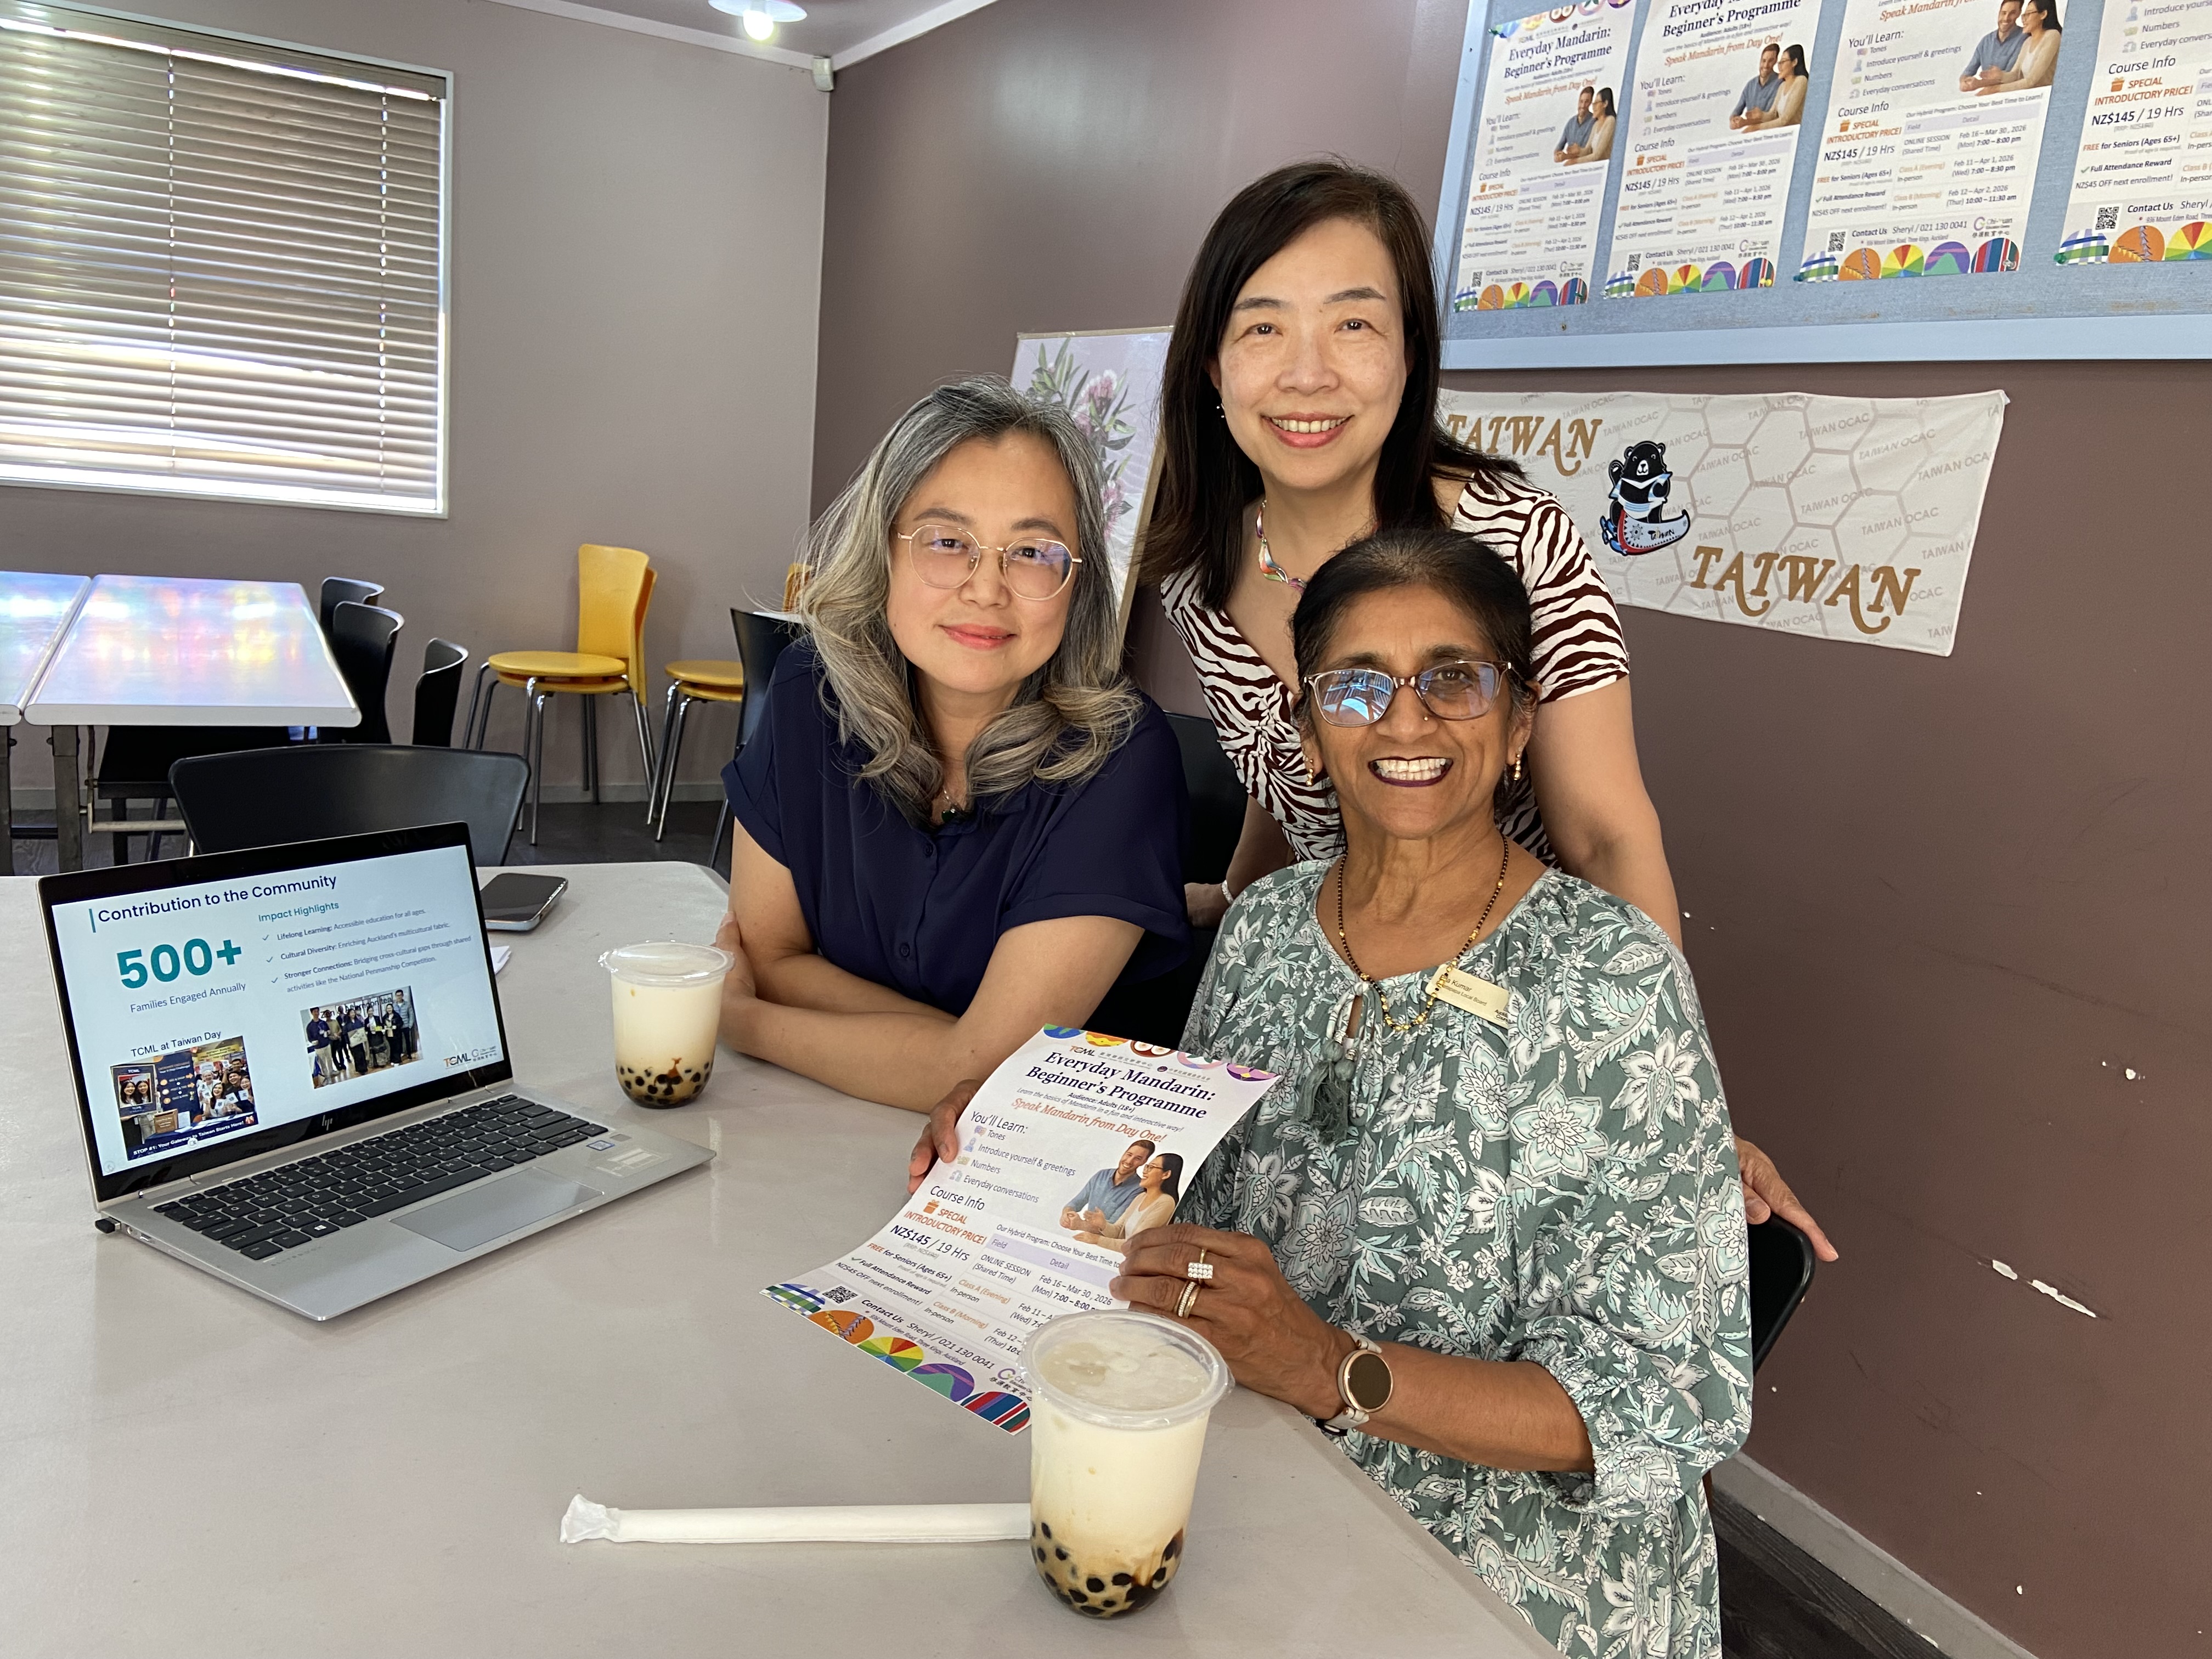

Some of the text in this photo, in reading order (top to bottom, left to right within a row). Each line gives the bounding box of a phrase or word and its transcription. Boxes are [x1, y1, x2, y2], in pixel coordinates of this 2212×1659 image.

[2142, 21, 2180, 32] Numbers
[2109, 55, 2176, 74] Course Info
[2095, 85, 2193, 106] INTRODUCTORY PRICE!
[2128, 77, 2163, 89] SPECIAL
[2092, 111, 2135, 126] NZ$145
[2147, 108, 2161, 119] 19
[2164, 106, 2184, 117] Hrs
[2113, 140, 2139, 148] Seniors
[2141, 138, 2161, 146] (Ages
[2163, 134, 2180, 143] 65+)
[1824, 149, 1858, 161] NZ$145
[1447, 414, 1603, 476] TAIWAN
[1690, 545, 1921, 634] TAIWAN
[98, 876, 336, 922] Contribution to the Community
[258, 902, 339, 922] Impact Highlights
[277, 932, 303, 940] Lifelong
[304, 926, 332, 935] Learning:
[334, 920, 364, 930] Accessible
[365, 915, 394, 924] education
[280, 950, 306, 960] Cultural
[307, 945, 337, 955] Diversity:
[338, 939, 366, 949] Enriching
[284, 969, 312, 979] Stronger
[313, 961, 353, 973] Connections:
[353, 956, 379, 965] Bridging
[431, 940, 453, 949] through
[453, 935, 471, 944] shared
[116, 938, 242, 989] 500+
[287, 983, 314, 992] activities
[339, 970, 364, 981] National
[365, 964, 400, 975] Penmanship
[130, 982, 246, 1013] Families Engaged Annually
[131, 1031, 221, 1057] TCML at Taiwan Day
[1043, 1052, 1121, 1079] Everyday
[1120, 1069, 1215, 1101] Mandarin:
[1025, 1066, 1207, 1118] Beginner's Programme
[1067, 1092, 1136, 1113] Audience: Adults (18+)
[970, 1111, 1028, 1134] You'll Learn:
[1011, 1098, 1167, 1142] Speak Mandarin from Day One!
[988, 1130, 1006, 1141] Tones
[970, 1159, 1001, 1174] Numbers
[978, 1144, 1009, 1159] Introduce
[1009, 1154, 1035, 1164] yourself
[1042, 1163, 1076, 1177] greetings
[930, 1186, 985, 1210] Course Info
[963, 1175, 1039, 1203] Everyday conversations
[904, 1211, 987, 1245] INTRODUCTORY PRICE!
[938, 1209, 967, 1224] SPECIAL
[890, 1225, 930, 1245] NZ$145
[936, 1243, 952, 1253] 19
[951, 1247, 970, 1261] Hrs
[991, 1239, 1008, 1249] Field
[1007, 1227, 1026, 1238] Hybrid
[1025, 1233, 1051, 1246] Program:
[1051, 1242, 1071, 1253] Choose
[1073, 1248, 1085, 1256] Your
[1085, 1252, 1098, 1261] Best
[1099, 1256, 1113, 1266] Time
[867, 1243, 884, 1252] FREE
[893, 1254, 917, 1267] Seniors
[916, 1263, 936, 1274] (Ages
[935, 1272, 952, 1282] 65+)
[972, 1263, 1017, 1284] (Shared Time)
[980, 1254, 1031, 1277] ONLINE SESSION
[1049, 1259, 1069, 1269] Detail
[836, 1262, 856, 1274] NZ$45
[868, 1279, 884, 1288] next
[883, 1286, 923, 1306] enrollment!
[870, 1266, 906, 1284] Attendance
[905, 1281, 932, 1295] Reward
[861, 1300, 892, 1317] Contact
[906, 1323, 935, 1338] Sheryl
[938, 1339, 956, 1350] 021
[955, 1347, 974, 1358] 130
[972, 1356, 995, 1369] 0041
